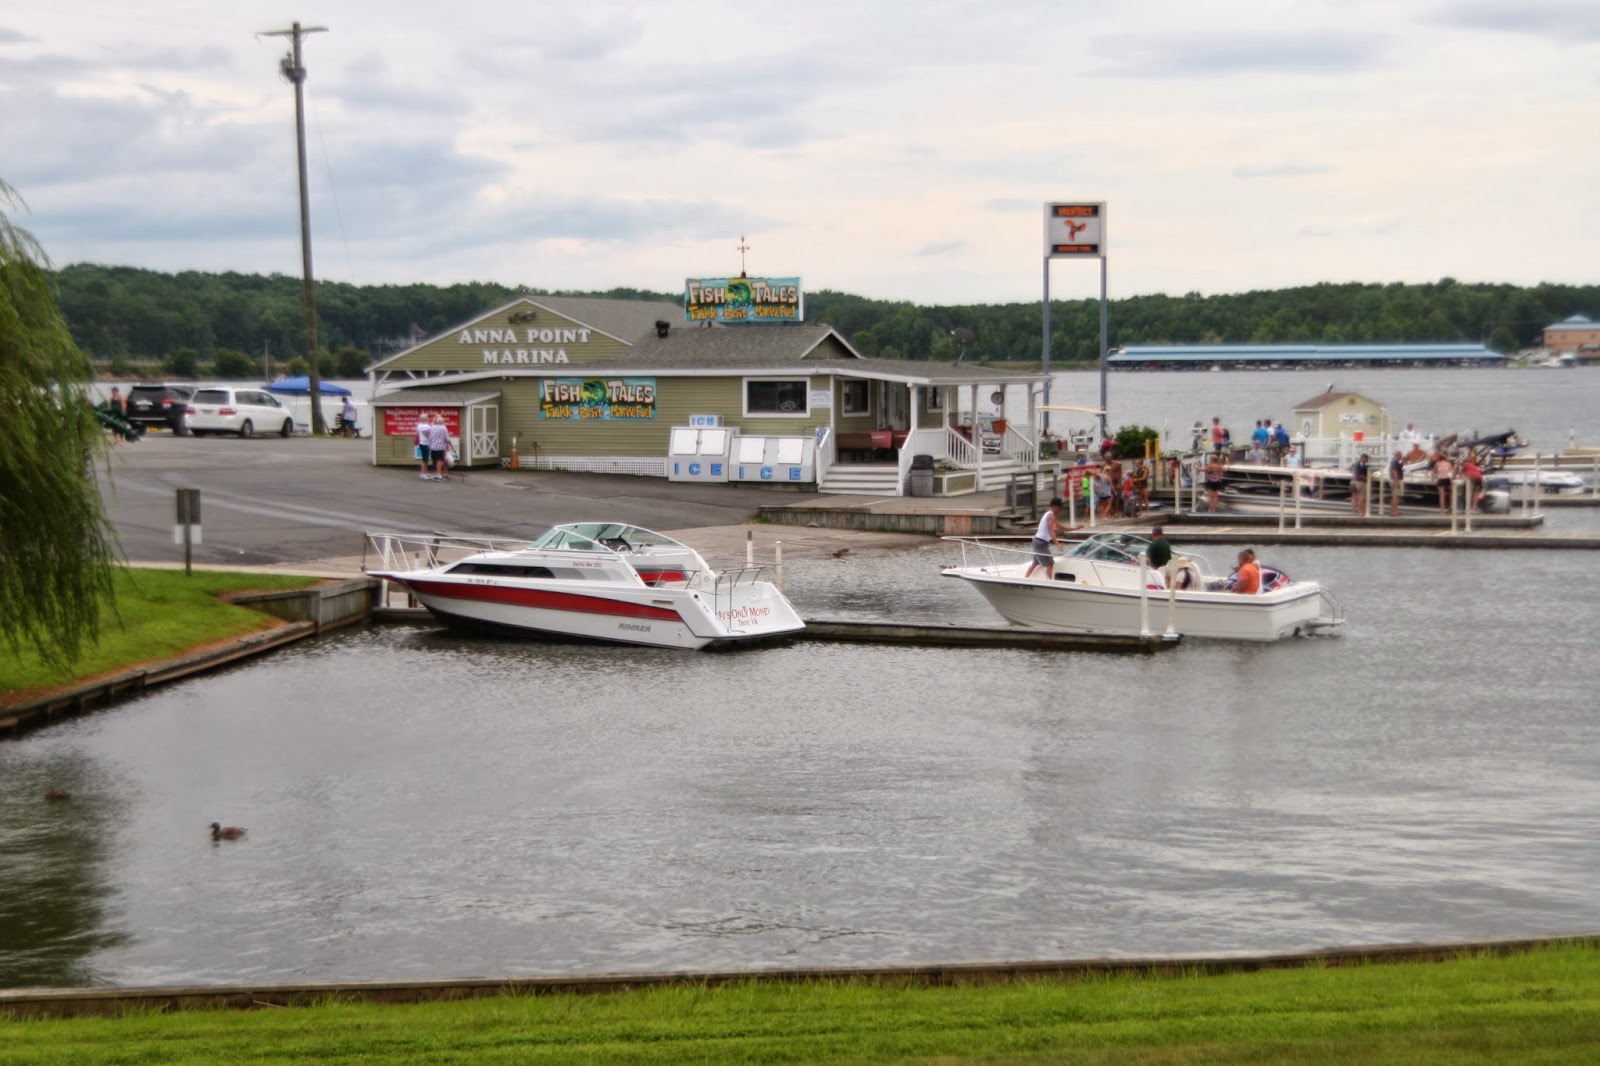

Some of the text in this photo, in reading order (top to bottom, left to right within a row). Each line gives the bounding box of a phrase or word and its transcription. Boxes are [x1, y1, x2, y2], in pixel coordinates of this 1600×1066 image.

[687, 281, 798, 304] FISH TALES
[459, 329, 591, 344] ANNA POINT
[482, 350, 569, 364] MARINA
[542, 380, 655, 404] FISH TALES
[691, 417, 715, 426] ICE
[674, 463, 722, 476] ICE
[738, 466, 801, 480] ICE
[731, 608, 748, 619] ONLY
